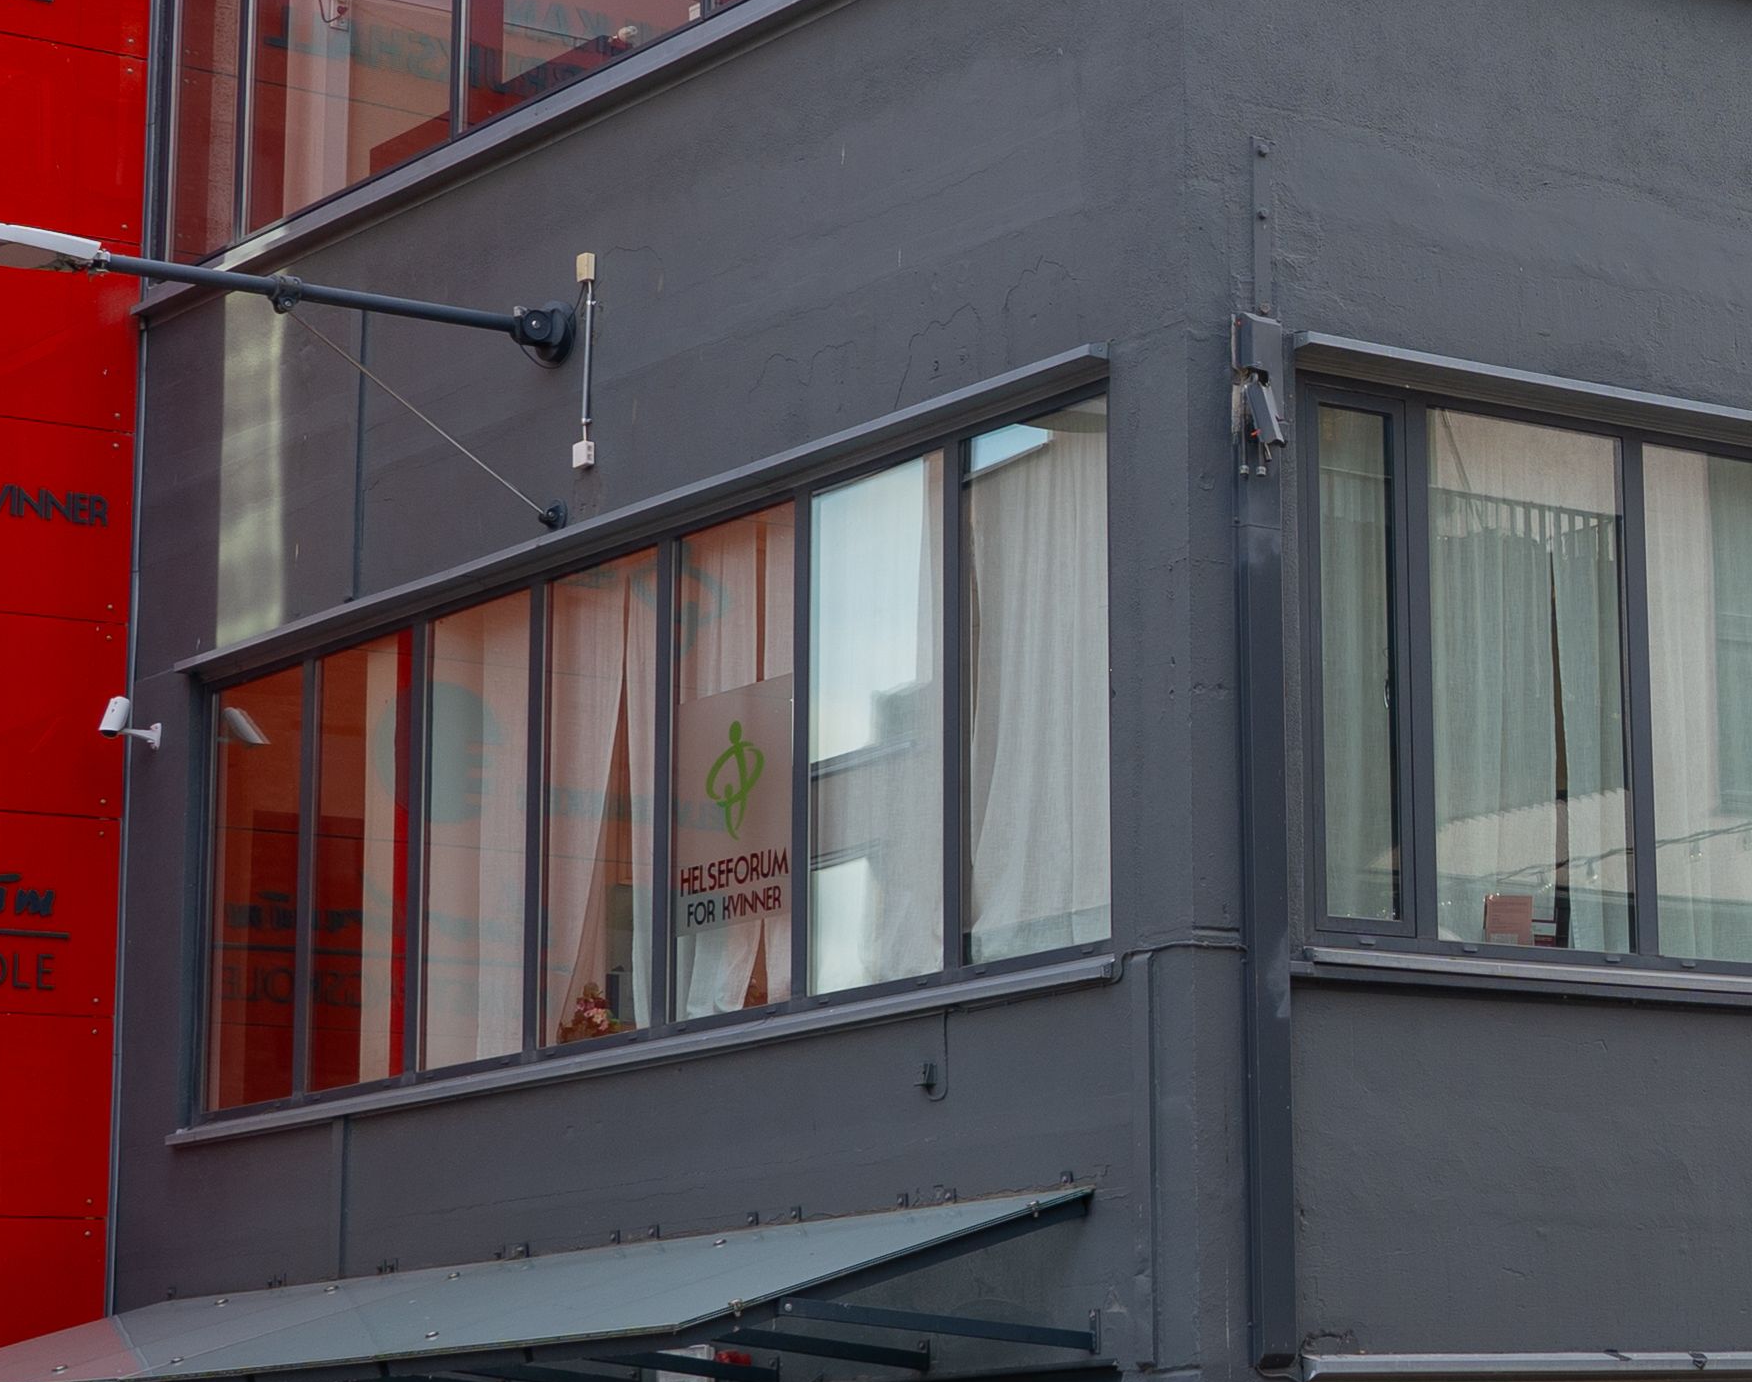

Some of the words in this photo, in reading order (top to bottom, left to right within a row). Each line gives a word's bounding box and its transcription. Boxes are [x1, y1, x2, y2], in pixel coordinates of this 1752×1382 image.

[680, 849, 789, 898] HELSEFORUM
[687, 898, 716, 927] FOR
[722, 886, 782, 920] KVINNER
